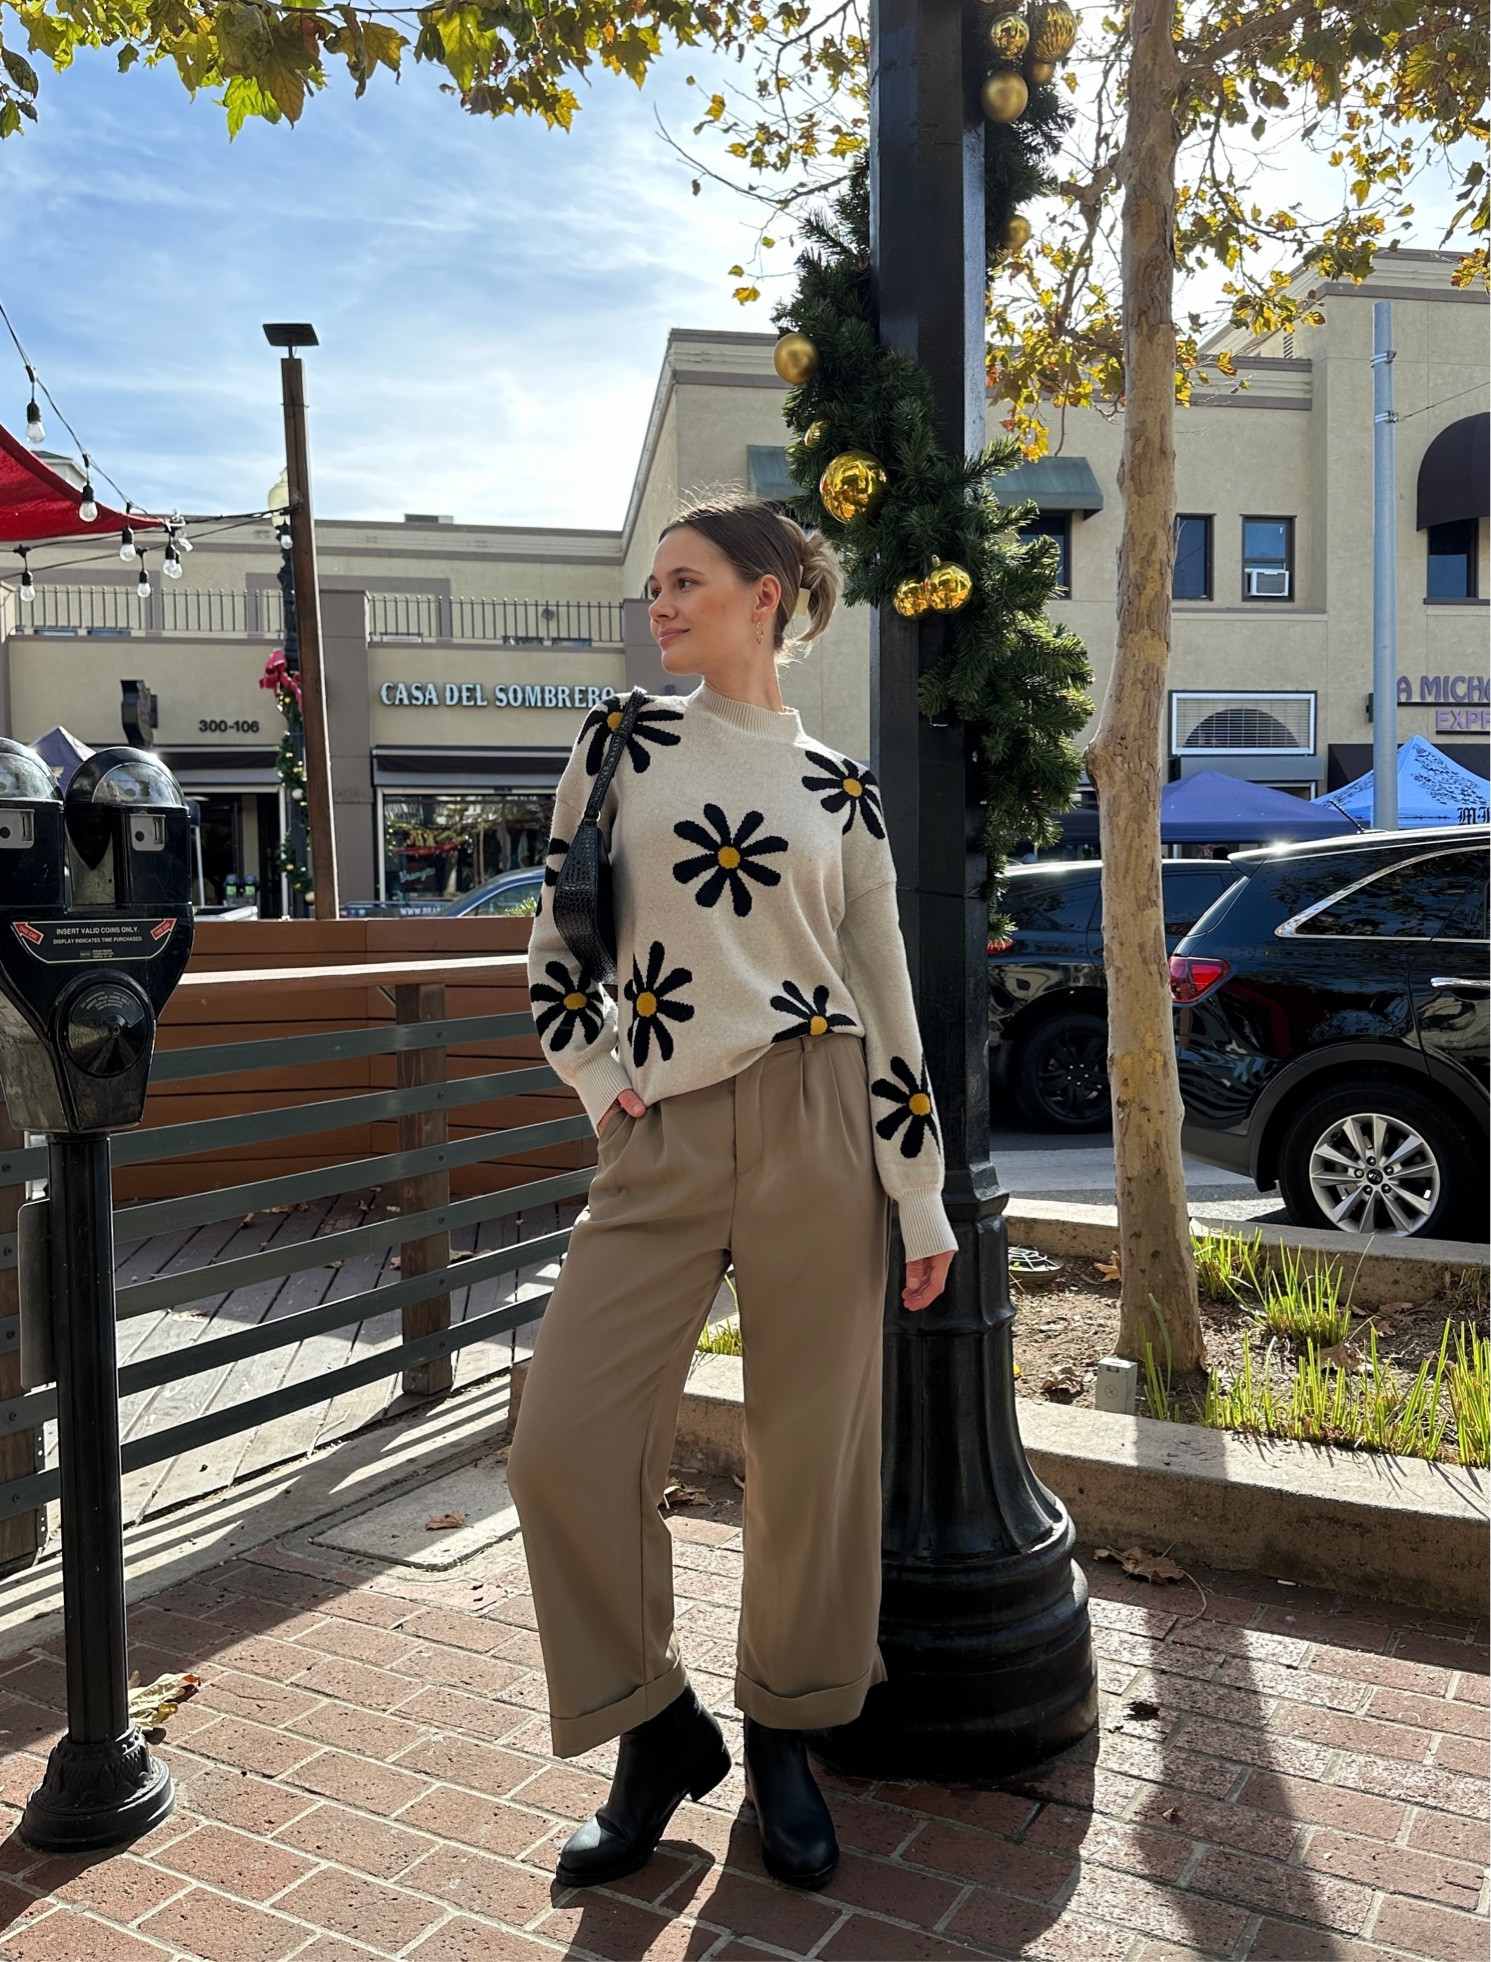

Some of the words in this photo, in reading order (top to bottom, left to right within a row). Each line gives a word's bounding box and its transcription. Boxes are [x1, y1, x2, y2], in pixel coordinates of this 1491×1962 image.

[380, 682, 439, 706] CASA
[444, 683, 488, 707] DEL
[494, 684, 616, 709] SOMBRERO
[199, 719, 260, 733] 300-106
[56, 927, 80, 935] INSERT
[80, 927, 100, 935] VALID
[100, 926, 121, 934] COINS
